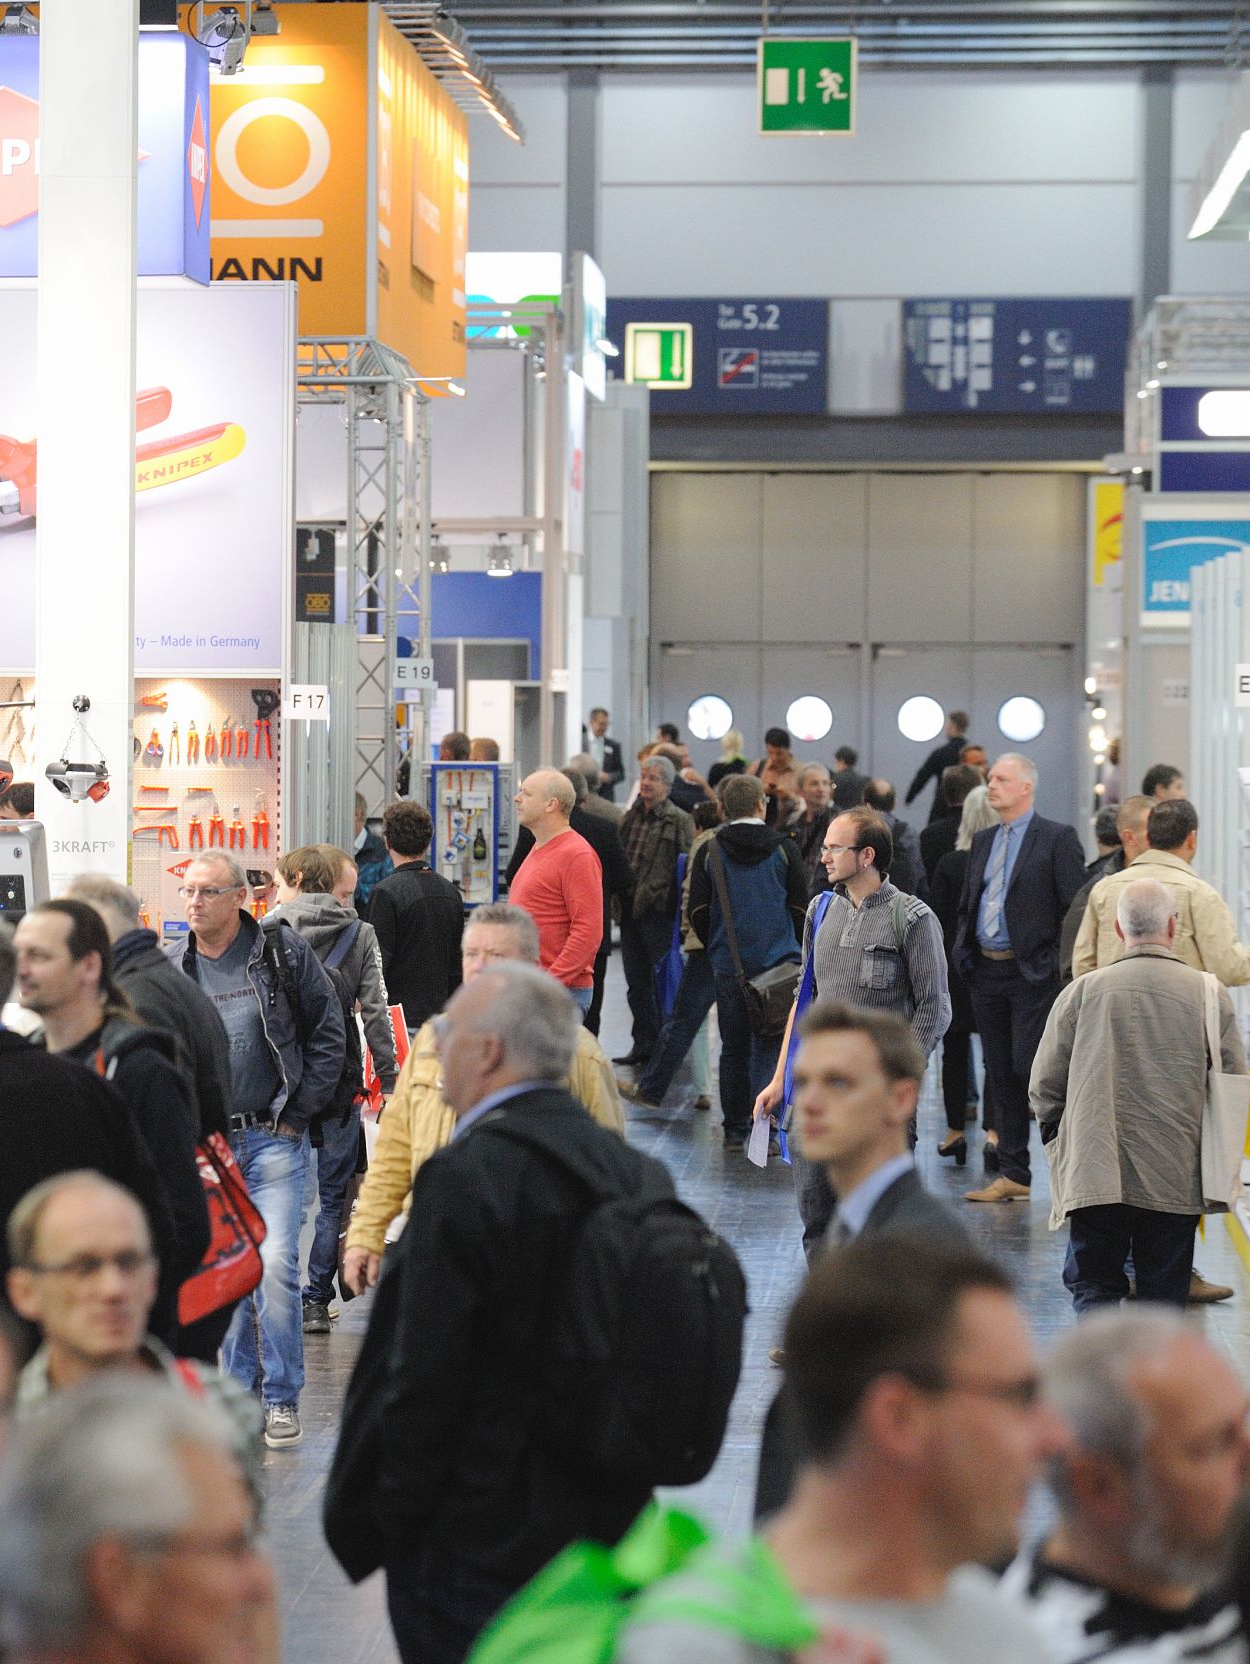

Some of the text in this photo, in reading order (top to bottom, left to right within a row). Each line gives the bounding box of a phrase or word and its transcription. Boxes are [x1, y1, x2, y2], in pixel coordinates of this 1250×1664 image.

[210, 257, 323, 282] ANN
[742, 304, 781, 331] 5.2
[137, 451, 213, 483] KNIPEX
[161, 635, 192, 647] Made
[196, 635, 206, 647] in
[210, 635, 261, 650] Germany
[397, 666, 431, 680] E 19
[1239, 676, 1250, 693] E
[293, 694, 325, 708] F 17
